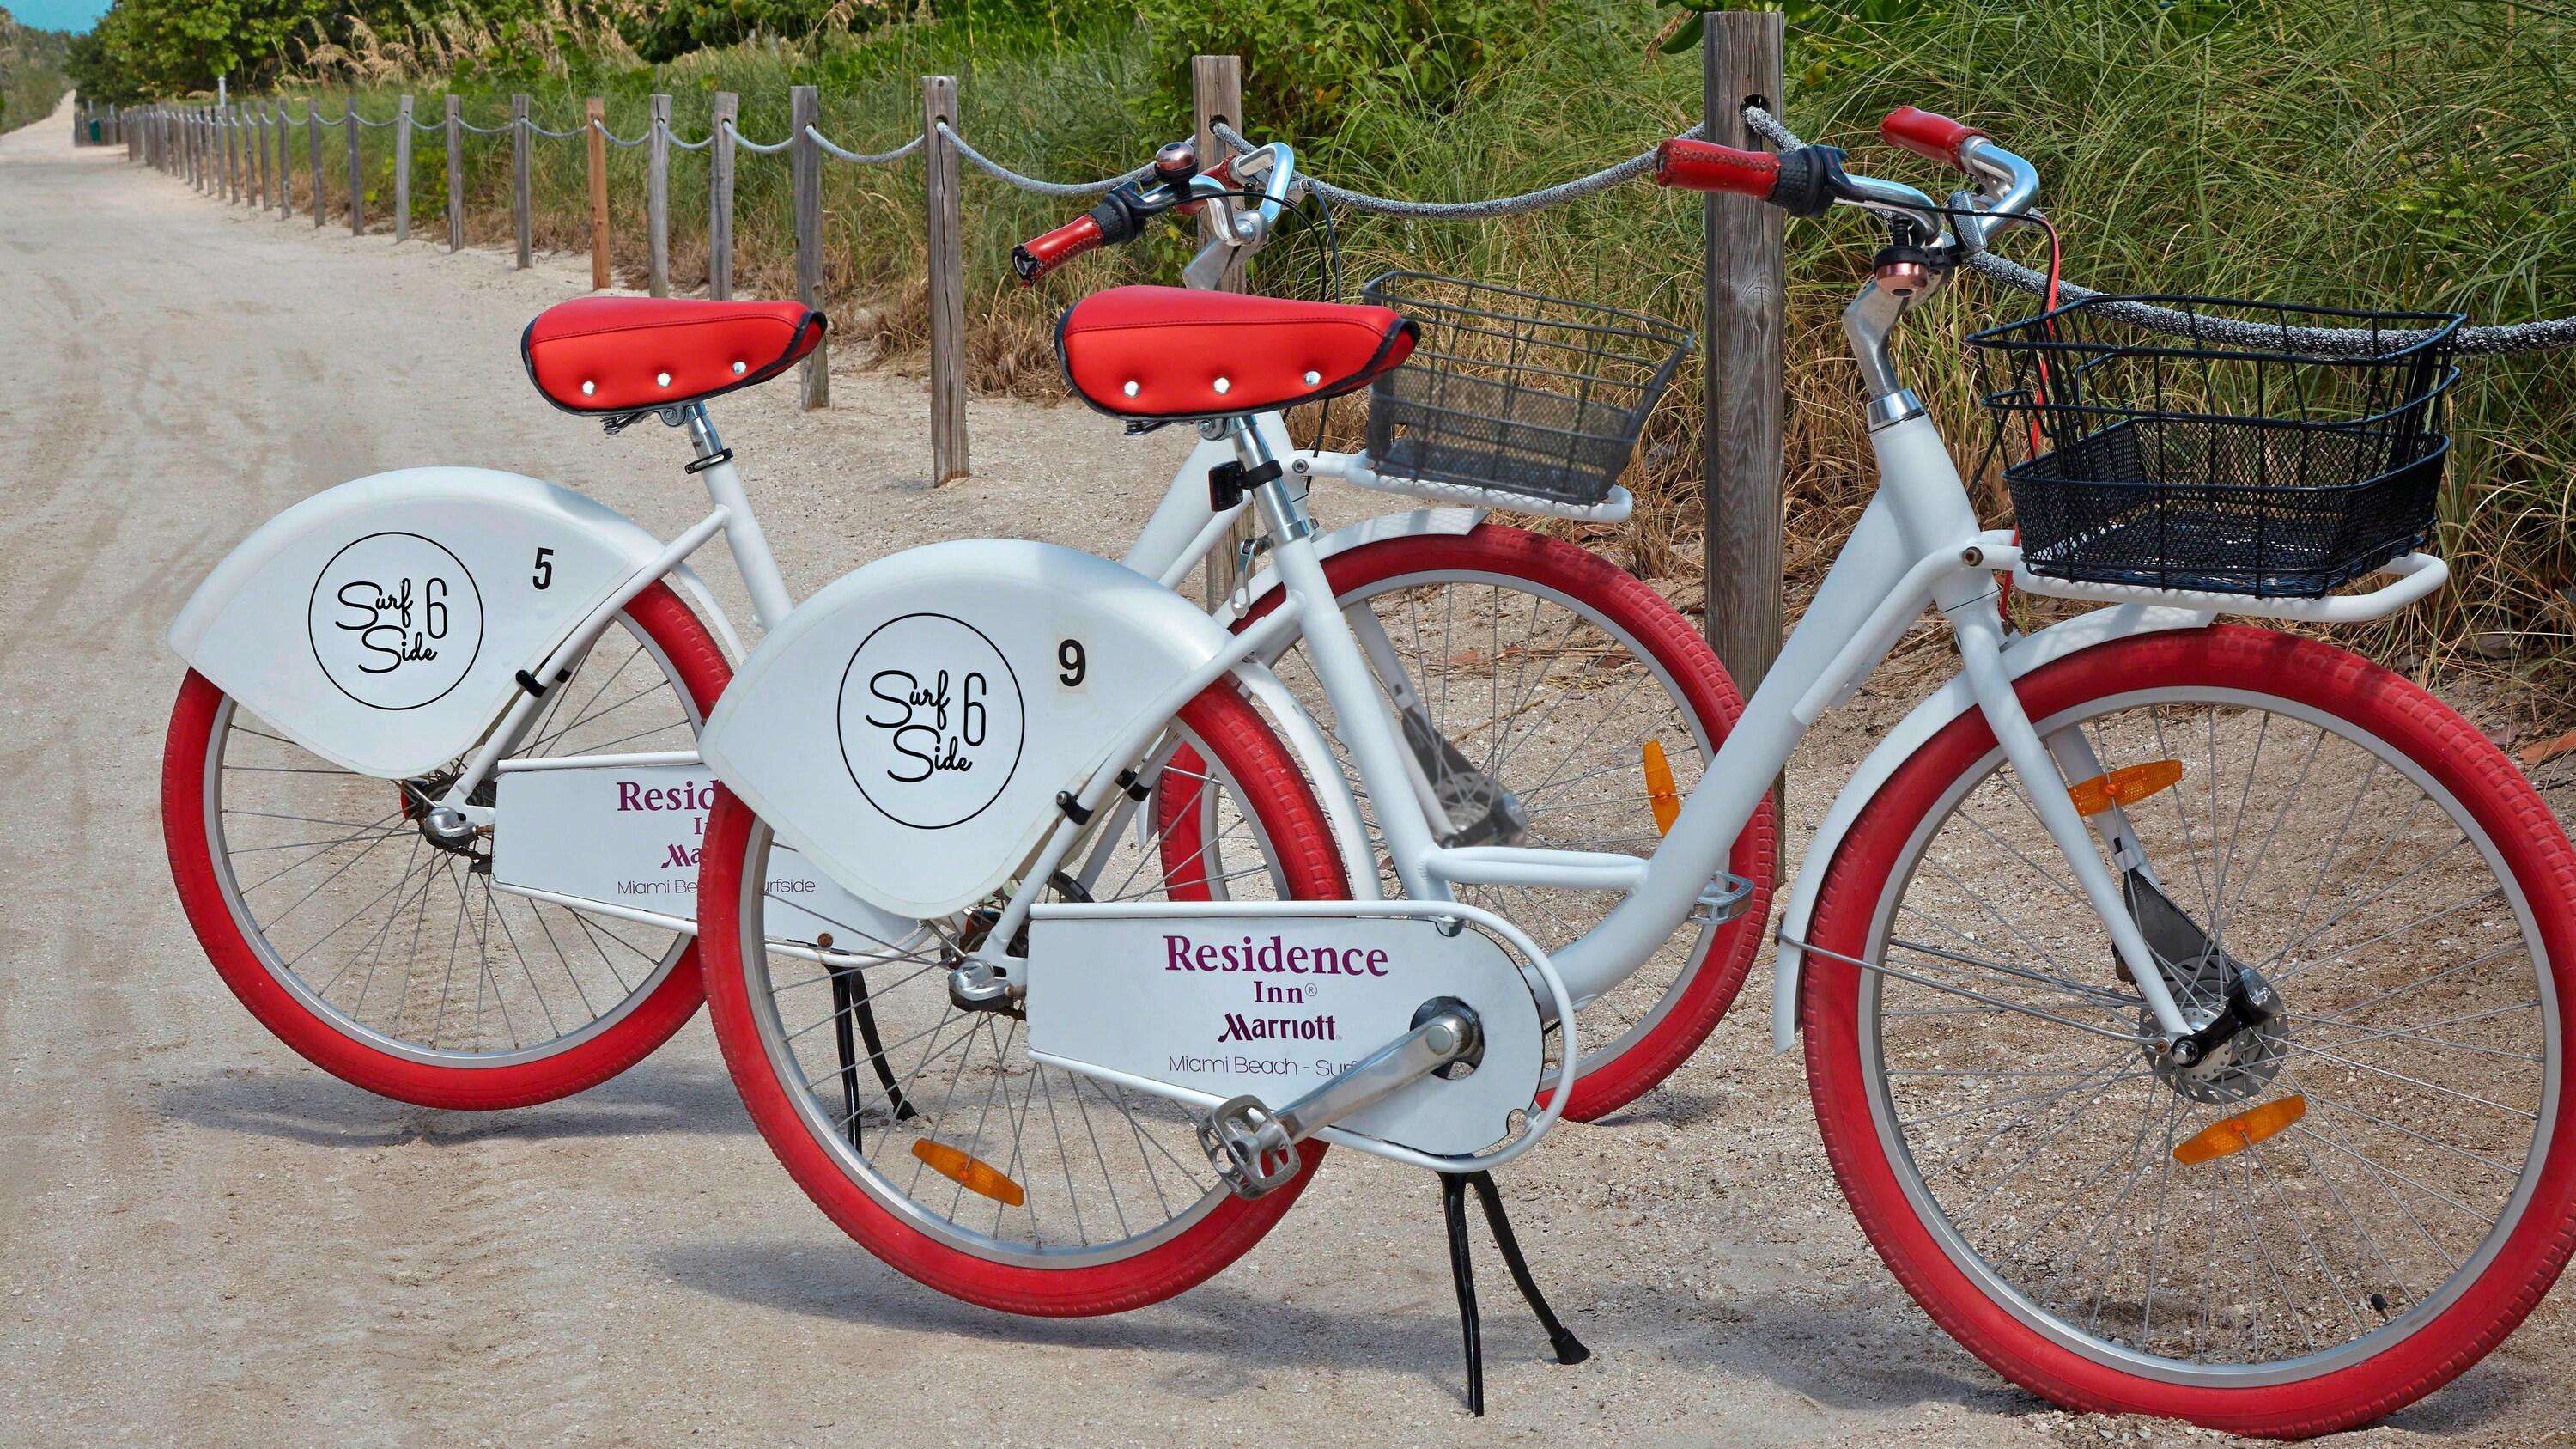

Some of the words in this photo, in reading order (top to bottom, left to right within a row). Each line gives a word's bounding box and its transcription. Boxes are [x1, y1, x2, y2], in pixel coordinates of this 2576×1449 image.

[533, 547, 554, 590] 5
[335, 578, 414, 630] Surf
[426, 577, 448, 639] 6
[357, 625, 439, 673] Side
[1058, 639, 1086, 687] 9
[866, 670, 951, 730] Surf
[963, 672, 987, 746] 6
[887, 725, 973, 782] Side
[617, 880, 670, 894] Miami
[1163, 935, 1388, 977] Residence
[1218, 1013, 1336, 1043] Marriott
[1170, 1056, 1228, 1073] Miami
[1234, 1056, 1297, 1075] Beach
